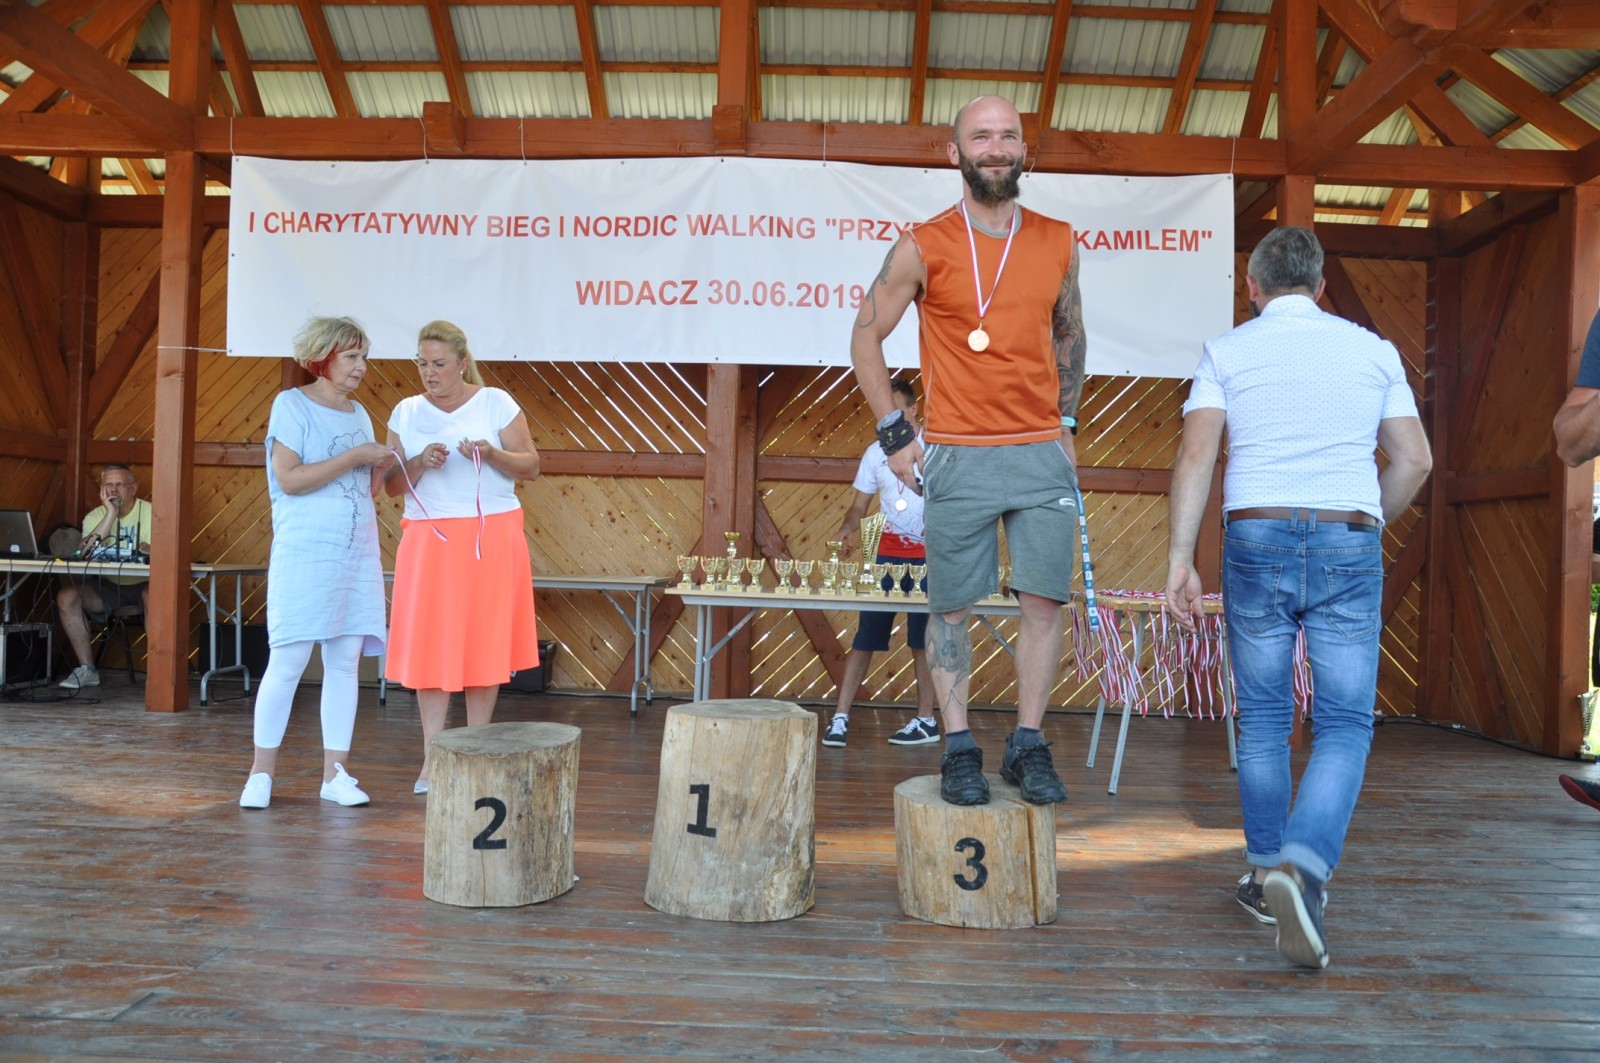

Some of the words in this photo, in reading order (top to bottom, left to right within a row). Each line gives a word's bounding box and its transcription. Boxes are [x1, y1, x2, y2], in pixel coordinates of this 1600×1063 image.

[249, 211, 255, 233] I
[263, 211, 478, 237] CHARYTATYWNY
[486, 215, 551, 238] BIEG
[559, 215, 565, 238] I
[573, 215, 678, 238] NORDIC
[686, 213, 817, 240] WALKING
[825, 218, 924, 242] "PRZY
[1073, 228, 1213, 252] KAMILEM"
[575, 280, 699, 306] WIDACZ
[707, 280, 865, 309] 30.06.2019
[472, 796, 507, 850] 2
[686, 783, 717, 838] 1
[953, 837, 988, 891] 3
